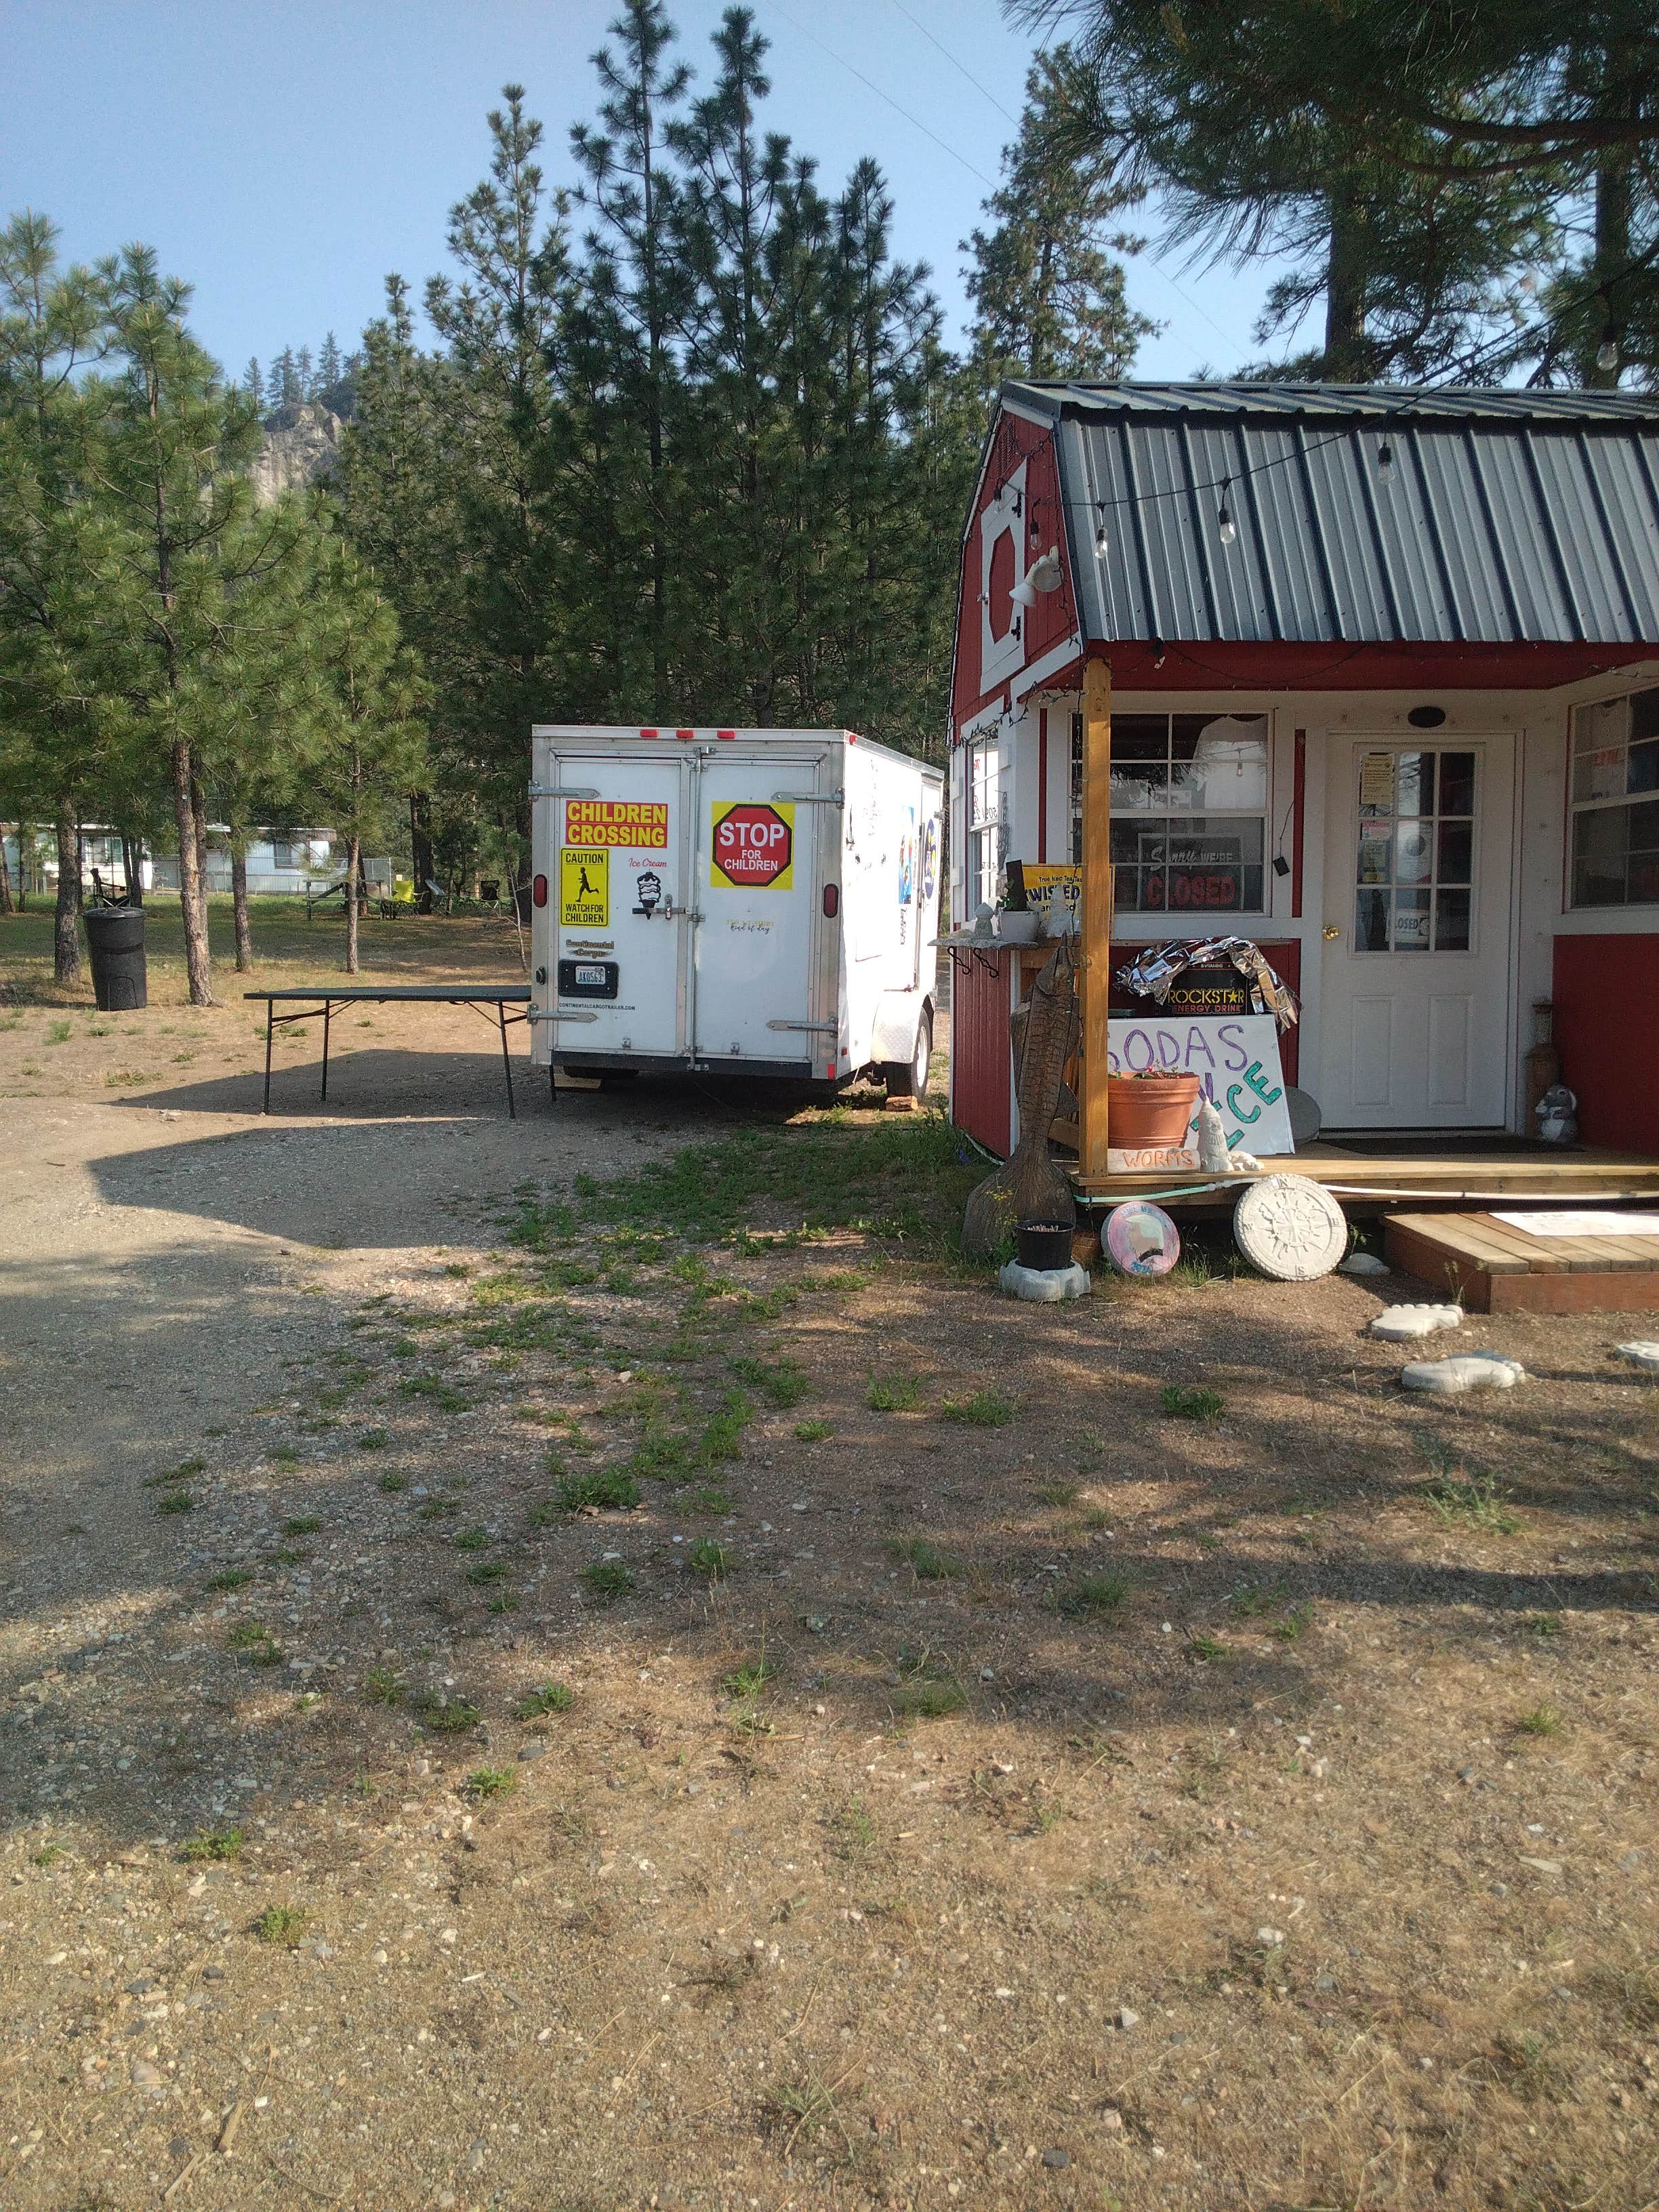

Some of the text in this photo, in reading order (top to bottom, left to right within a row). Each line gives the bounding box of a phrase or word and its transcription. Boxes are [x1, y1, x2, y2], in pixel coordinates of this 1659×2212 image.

[567, 802, 666, 824] CHILDREN
[568, 825, 665, 846] CROSSING
[719, 822, 785, 847] STOP
[565, 853, 604, 863] CAUTION
[741, 850, 761, 859] FOR
[1150, 846, 1196, 871] Srry
[628, 858, 668, 867] Ice Cream
[724, 859, 778, 871] CHILDREN
[1025, 884, 1080, 902] WISED
[566, 903, 604, 913] WATCH FOR
[565, 913, 604, 923] CHILDREN
[1173, 1004, 1242, 1012] ENERGY DRINK
[1123, 1150, 1195, 1169] WORMS
